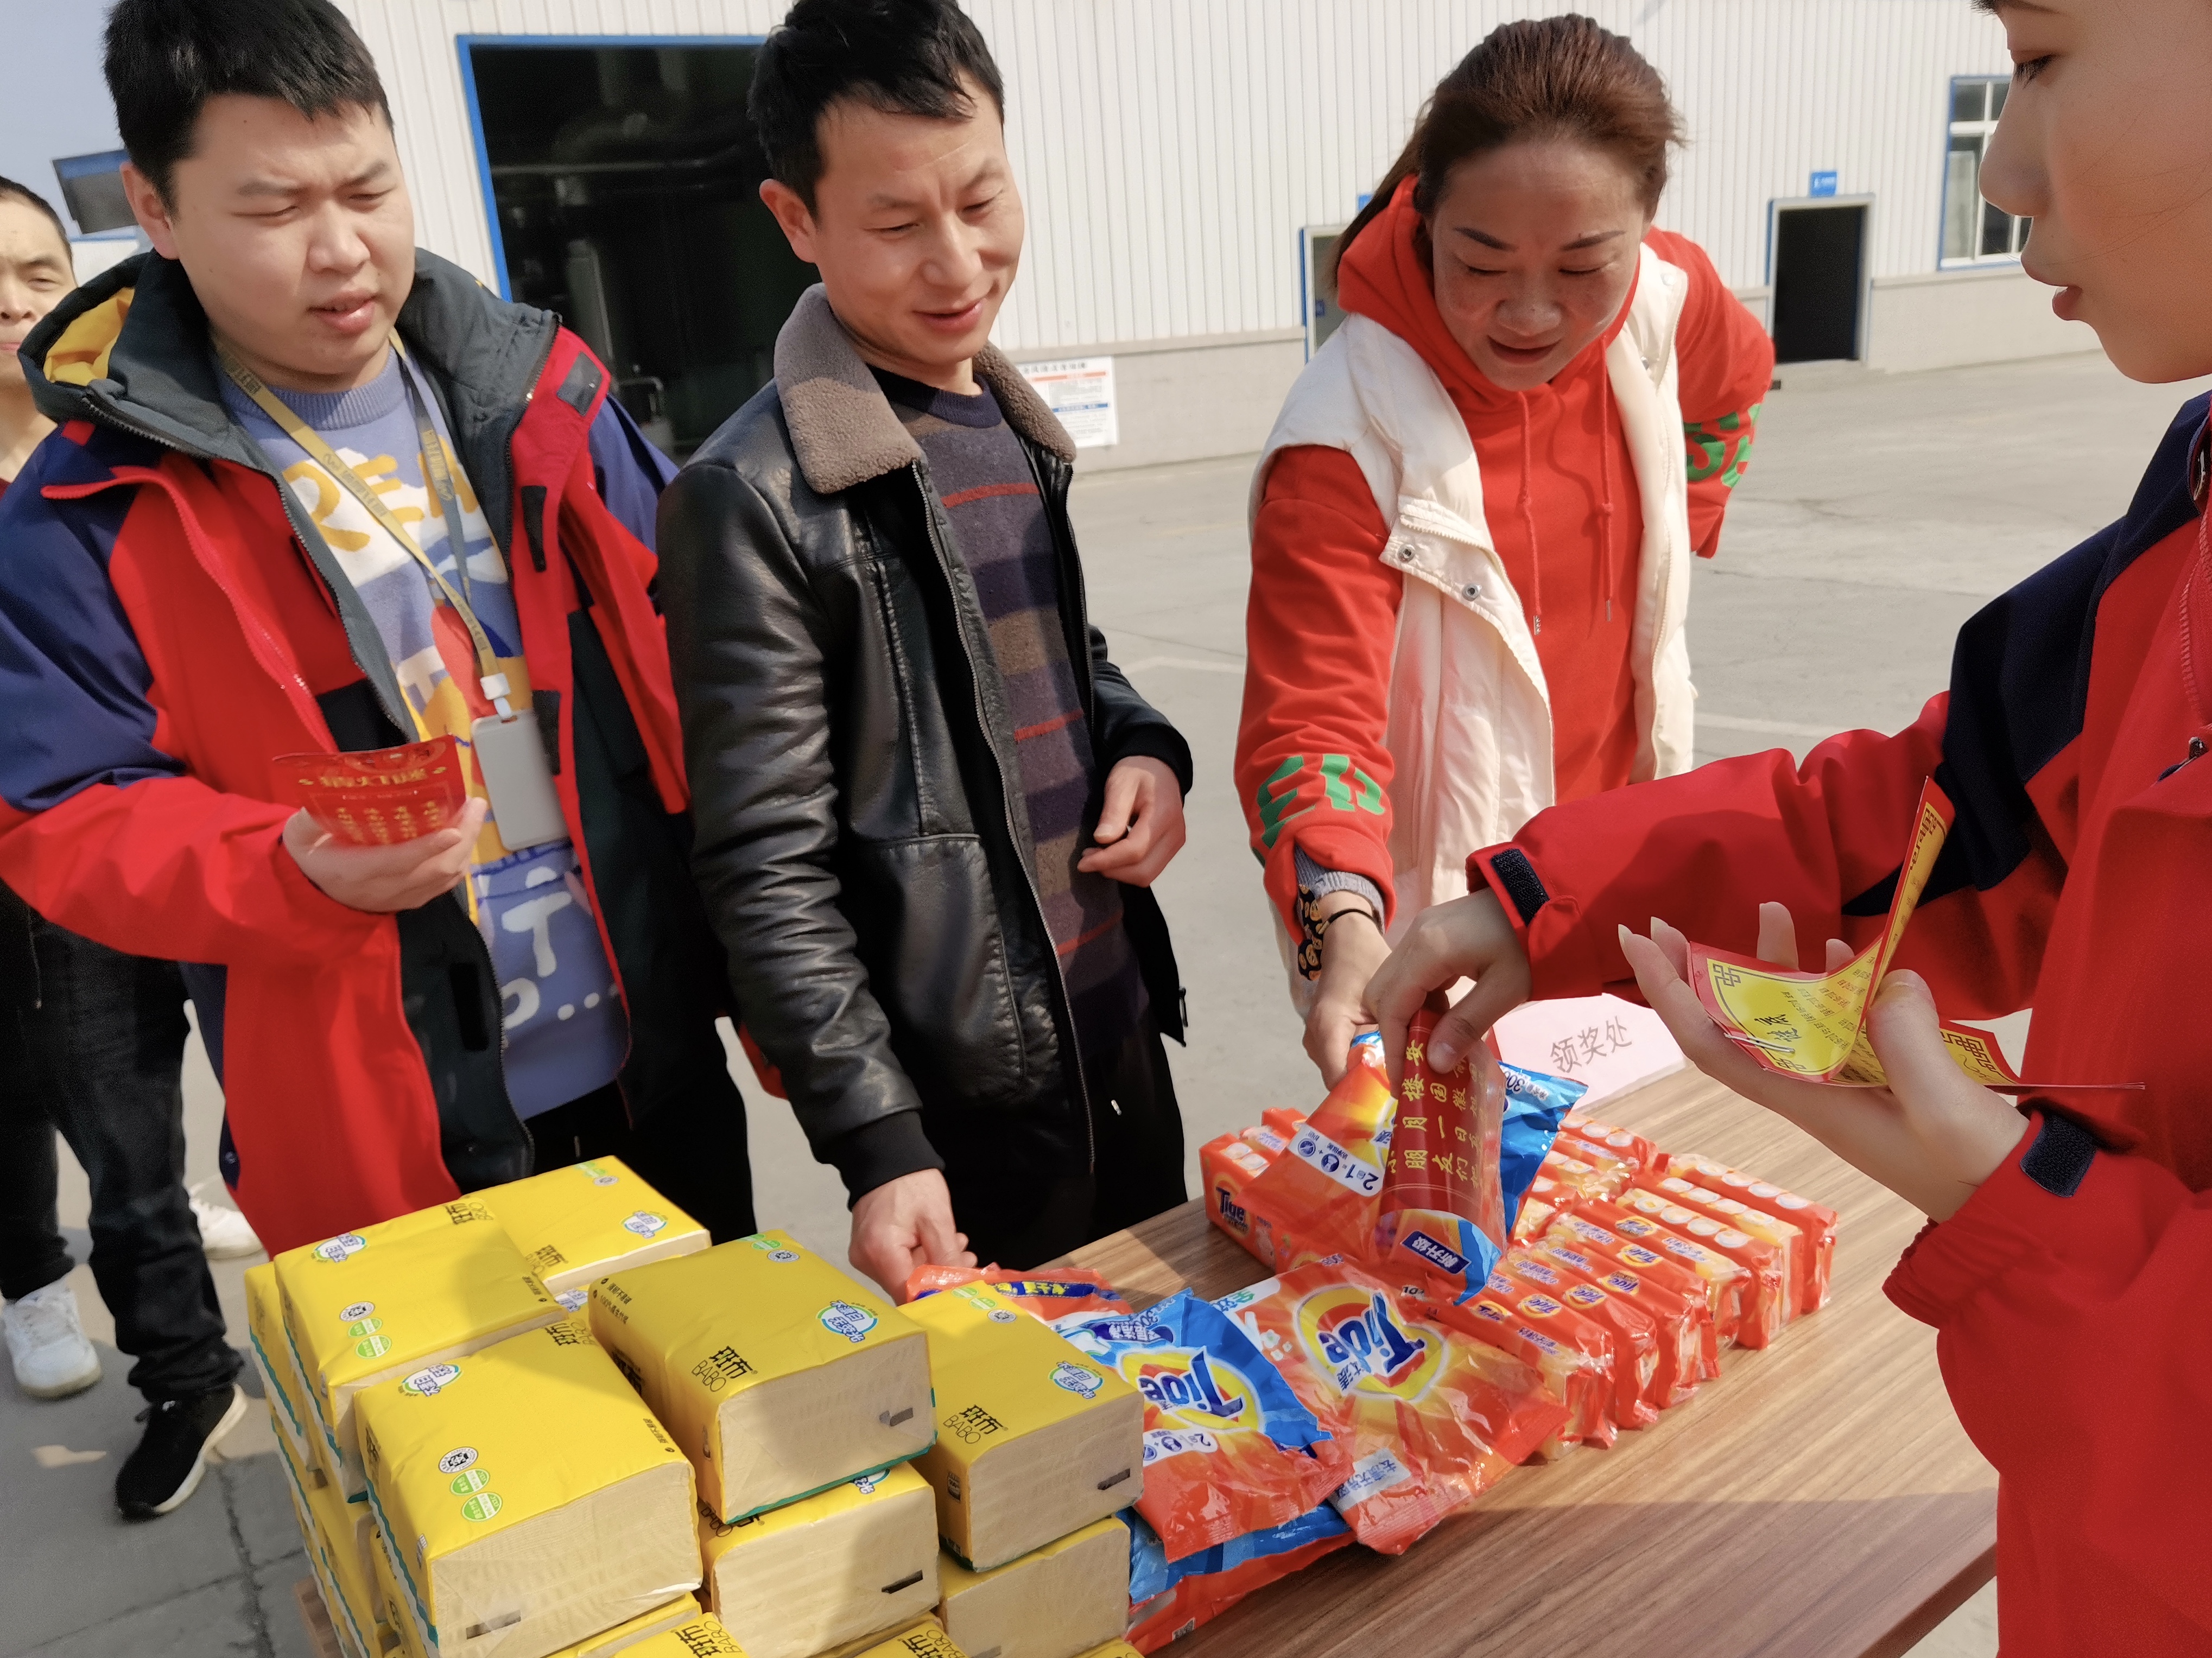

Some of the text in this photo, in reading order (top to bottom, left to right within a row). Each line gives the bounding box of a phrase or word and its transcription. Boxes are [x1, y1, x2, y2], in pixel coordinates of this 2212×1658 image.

[1550, 1015, 1632, 1073] 领奖处
[1411, 1235, 1459, 1268] 新升级
[829, 1300, 865, 1322] 不漂白
[544, 1322, 580, 1346] 班布
[828, 1317, 865, 1343] 无荧光
[1316, 1292, 1427, 1376] Tide
[691, 1360, 727, 1393] BABO
[709, 1346, 753, 1380] 班布
[1056, 1361, 1091, 1381] 不漂白
[1059, 1376, 1096, 1399] 无荧光
[1138, 1351, 1244, 1419] Tide
[942, 1414, 981, 1444] BABO
[959, 1404, 1004, 1436] 班布
[675, 1625, 722, 1658] 班布
[703, 1621, 743, 1653] BABO
